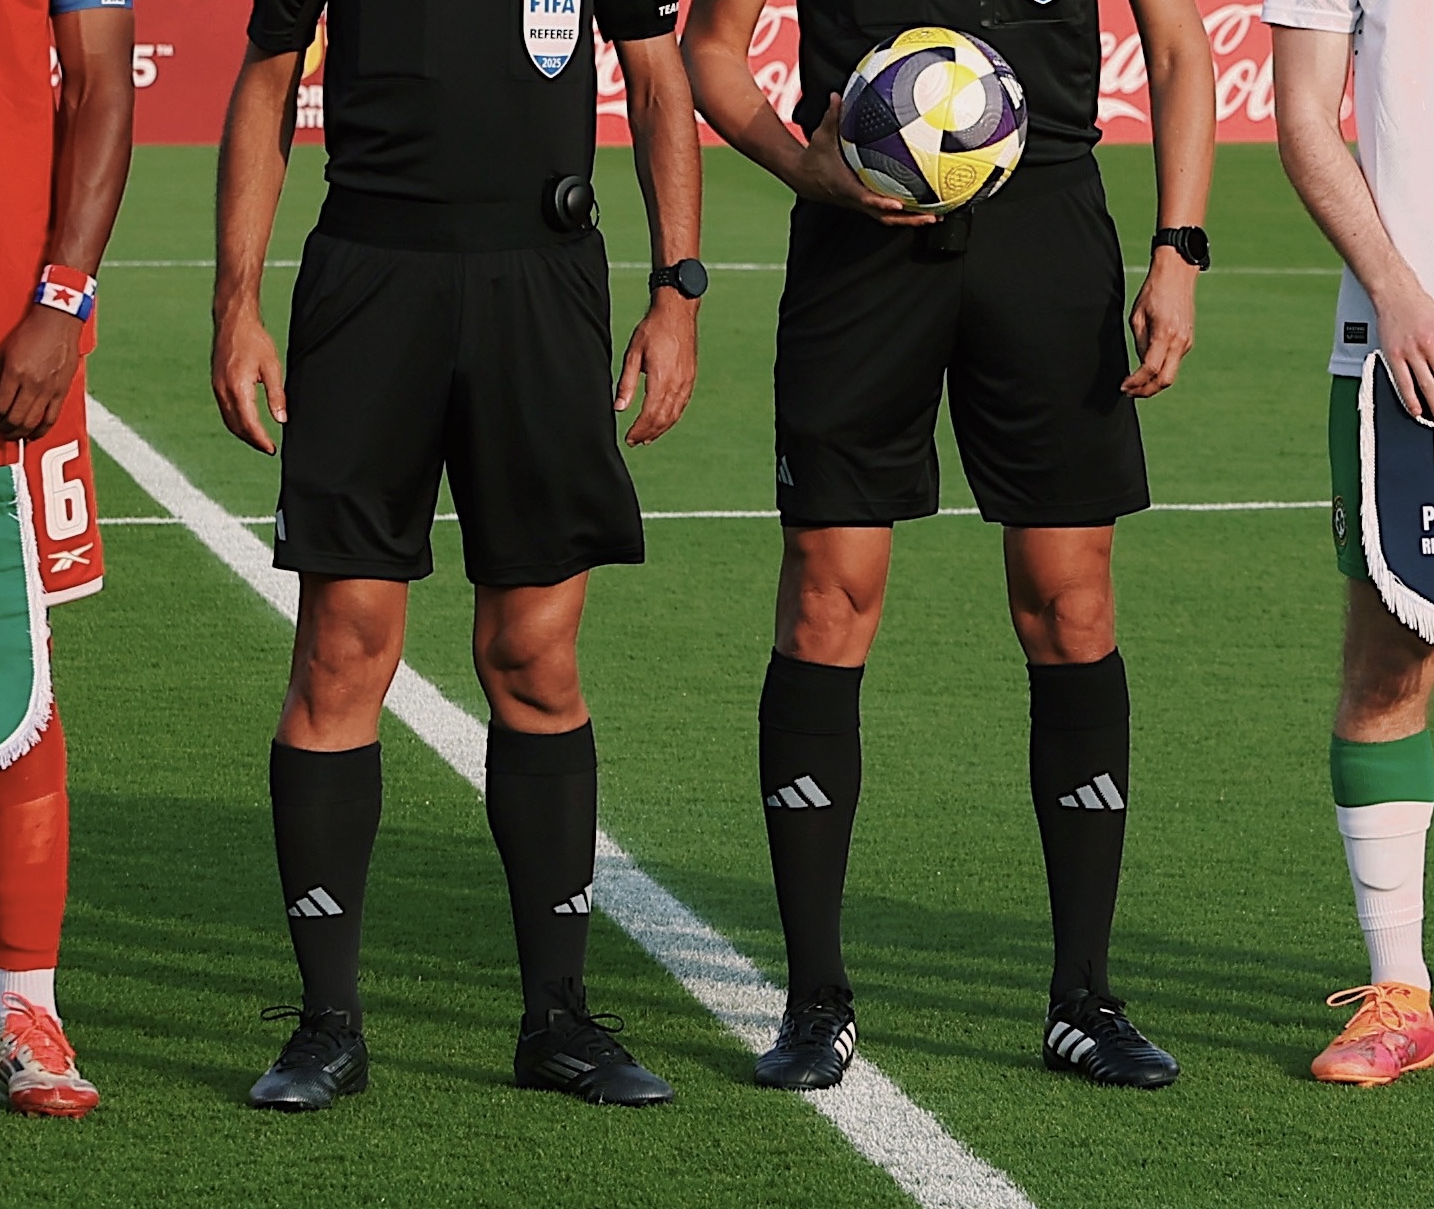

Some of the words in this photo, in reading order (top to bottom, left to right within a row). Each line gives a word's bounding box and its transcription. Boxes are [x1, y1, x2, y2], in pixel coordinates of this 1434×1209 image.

[530, 28, 574, 40] REFEREE
[541, 58, 562, 69] 2025
[41, 440, 88, 541] 6
